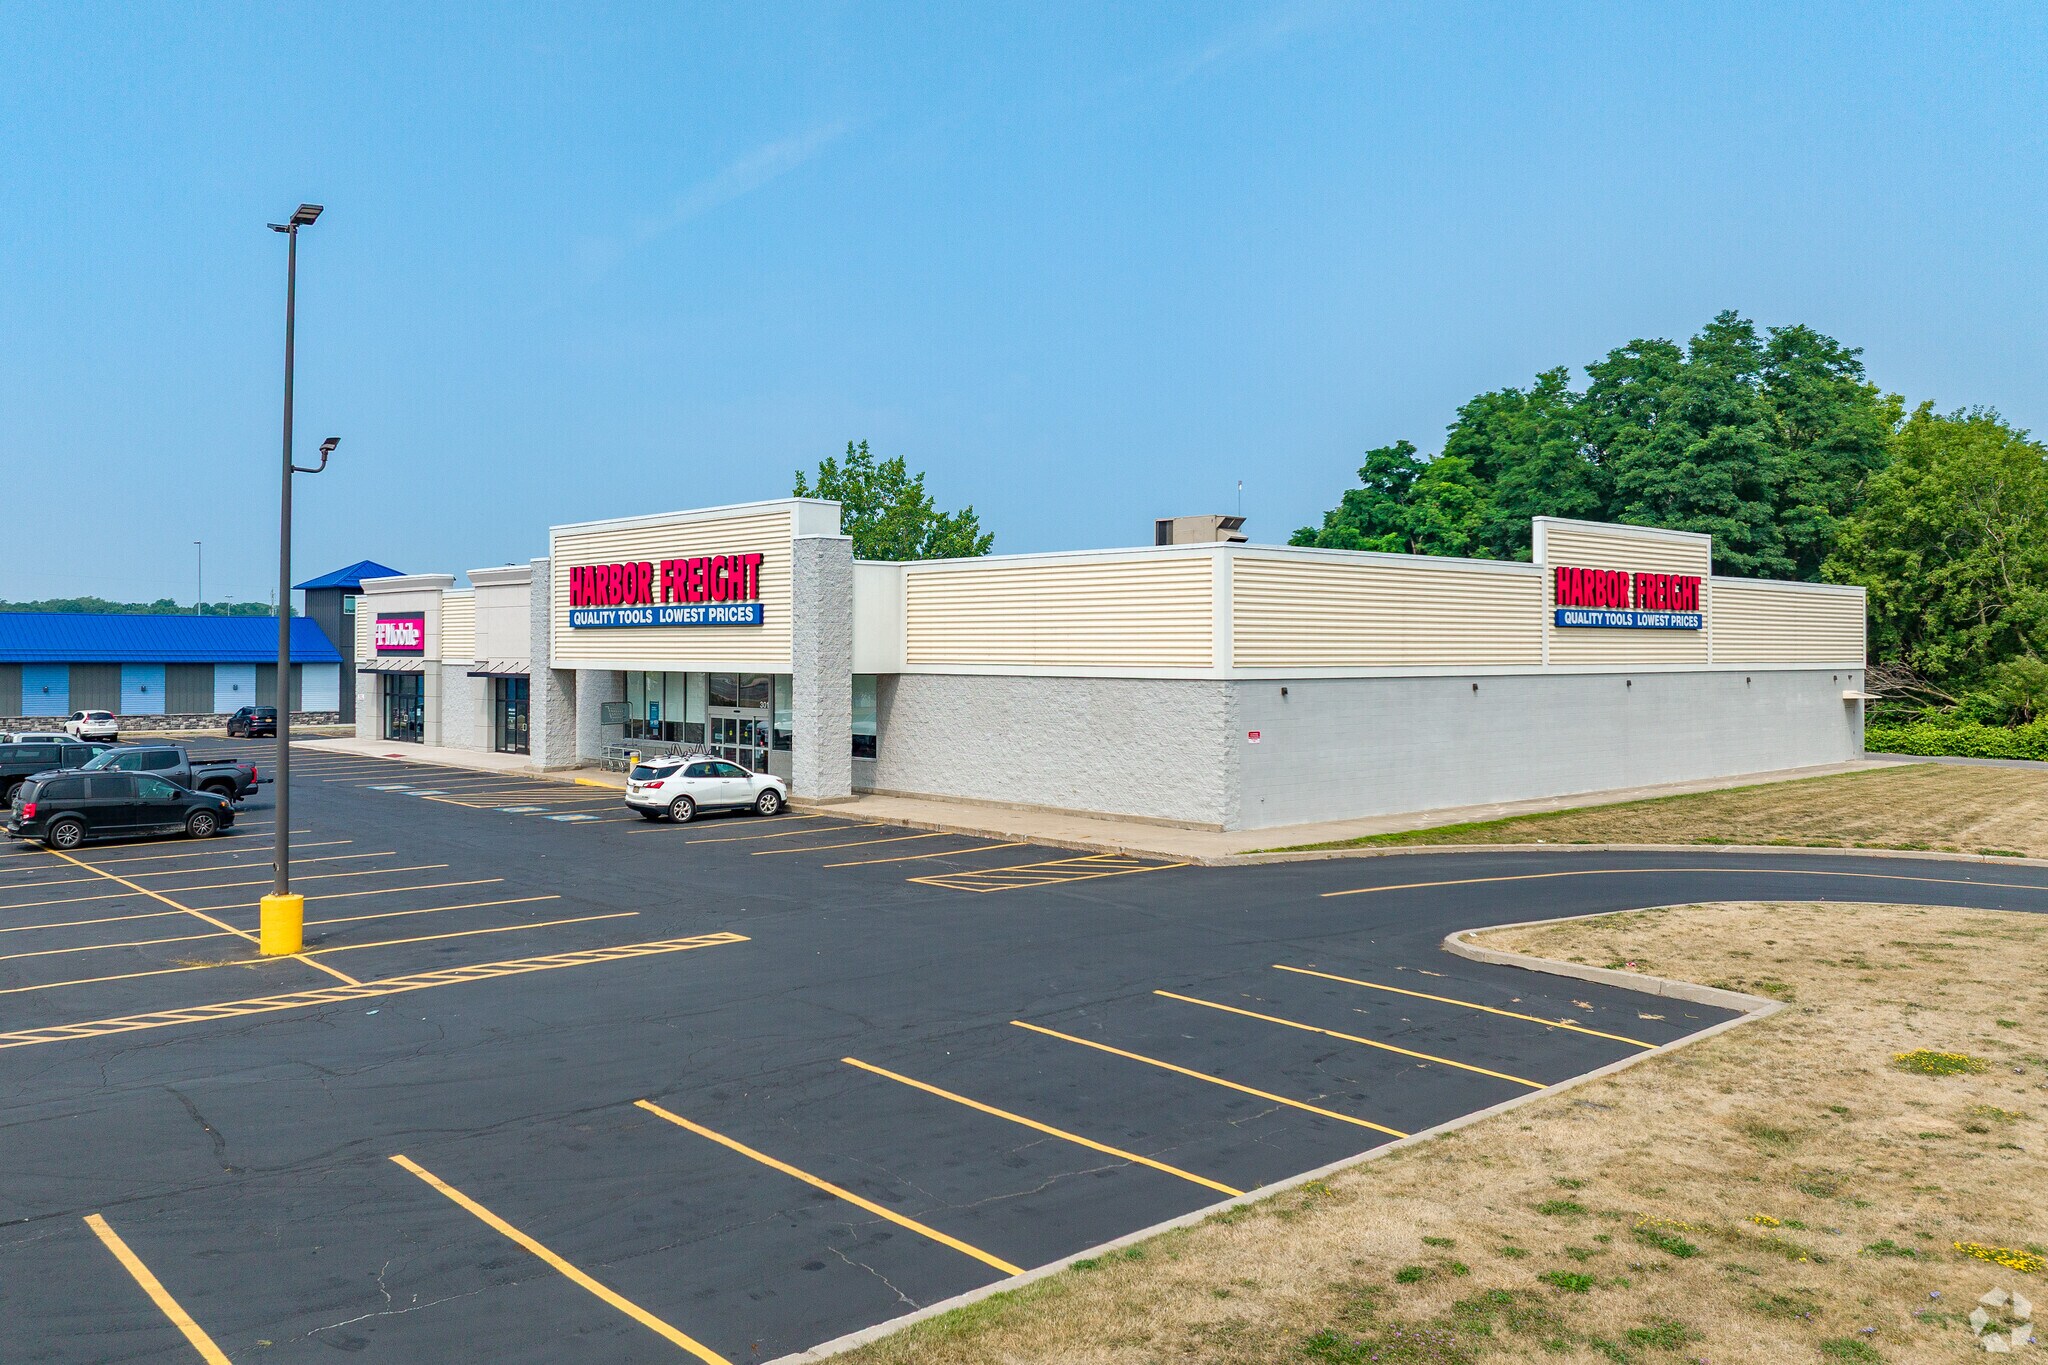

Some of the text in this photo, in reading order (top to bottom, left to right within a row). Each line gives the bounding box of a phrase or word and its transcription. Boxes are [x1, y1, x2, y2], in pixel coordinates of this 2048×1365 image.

[570, 553, 763, 606] HARBOR FREIGHT
[1556, 567, 1701, 611] HARBOR FREIGHT
[573, 606, 754, 625] QUALITY TOOLS LOWEST PRICES
[1564, 611, 1699, 627] QUALITY TOOLS LOWEST PRICES
